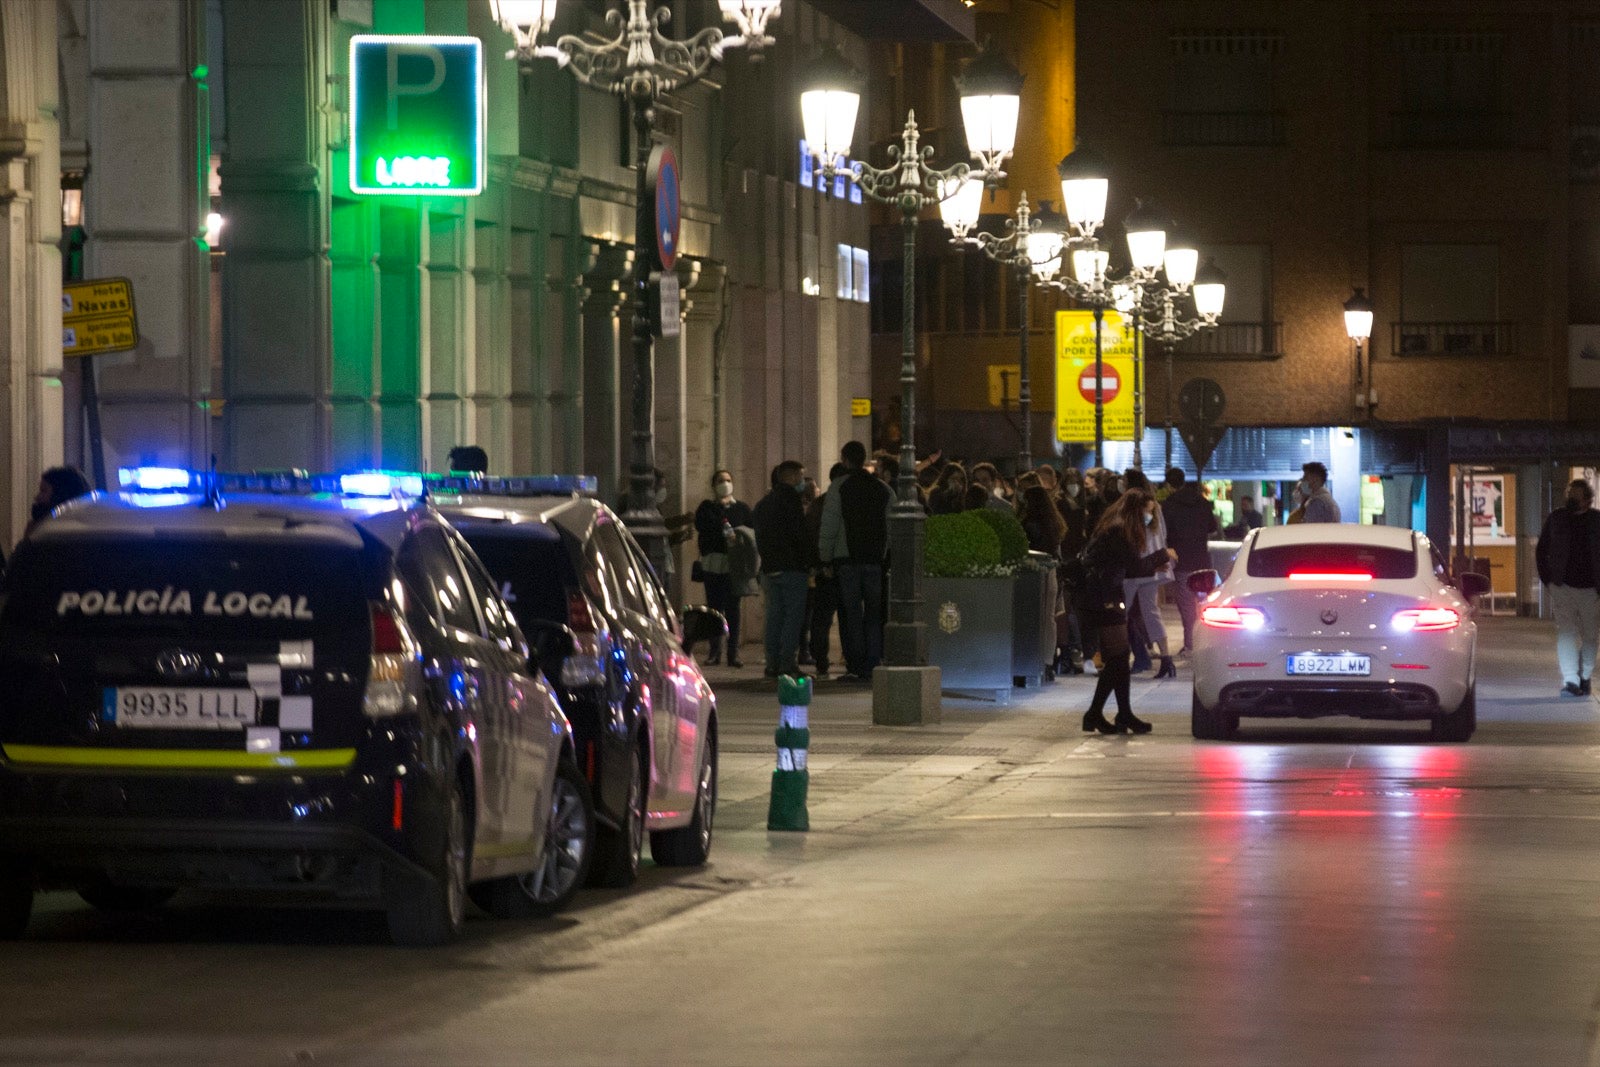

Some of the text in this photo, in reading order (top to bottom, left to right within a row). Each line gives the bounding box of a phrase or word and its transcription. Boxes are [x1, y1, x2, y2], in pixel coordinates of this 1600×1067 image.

[387, 44, 446, 129] P
[93, 284, 125, 296] Hotel
[78, 299, 126, 312] Navas
[1072, 336, 1126, 345] CONROL
[1064, 347, 1135, 355] POR CMARA
[57, 585, 313, 620] POLICÍA LOCAL
[1297, 659, 1366, 671] 8922 LMM
[123, 693, 247, 718] 9935 LLL
